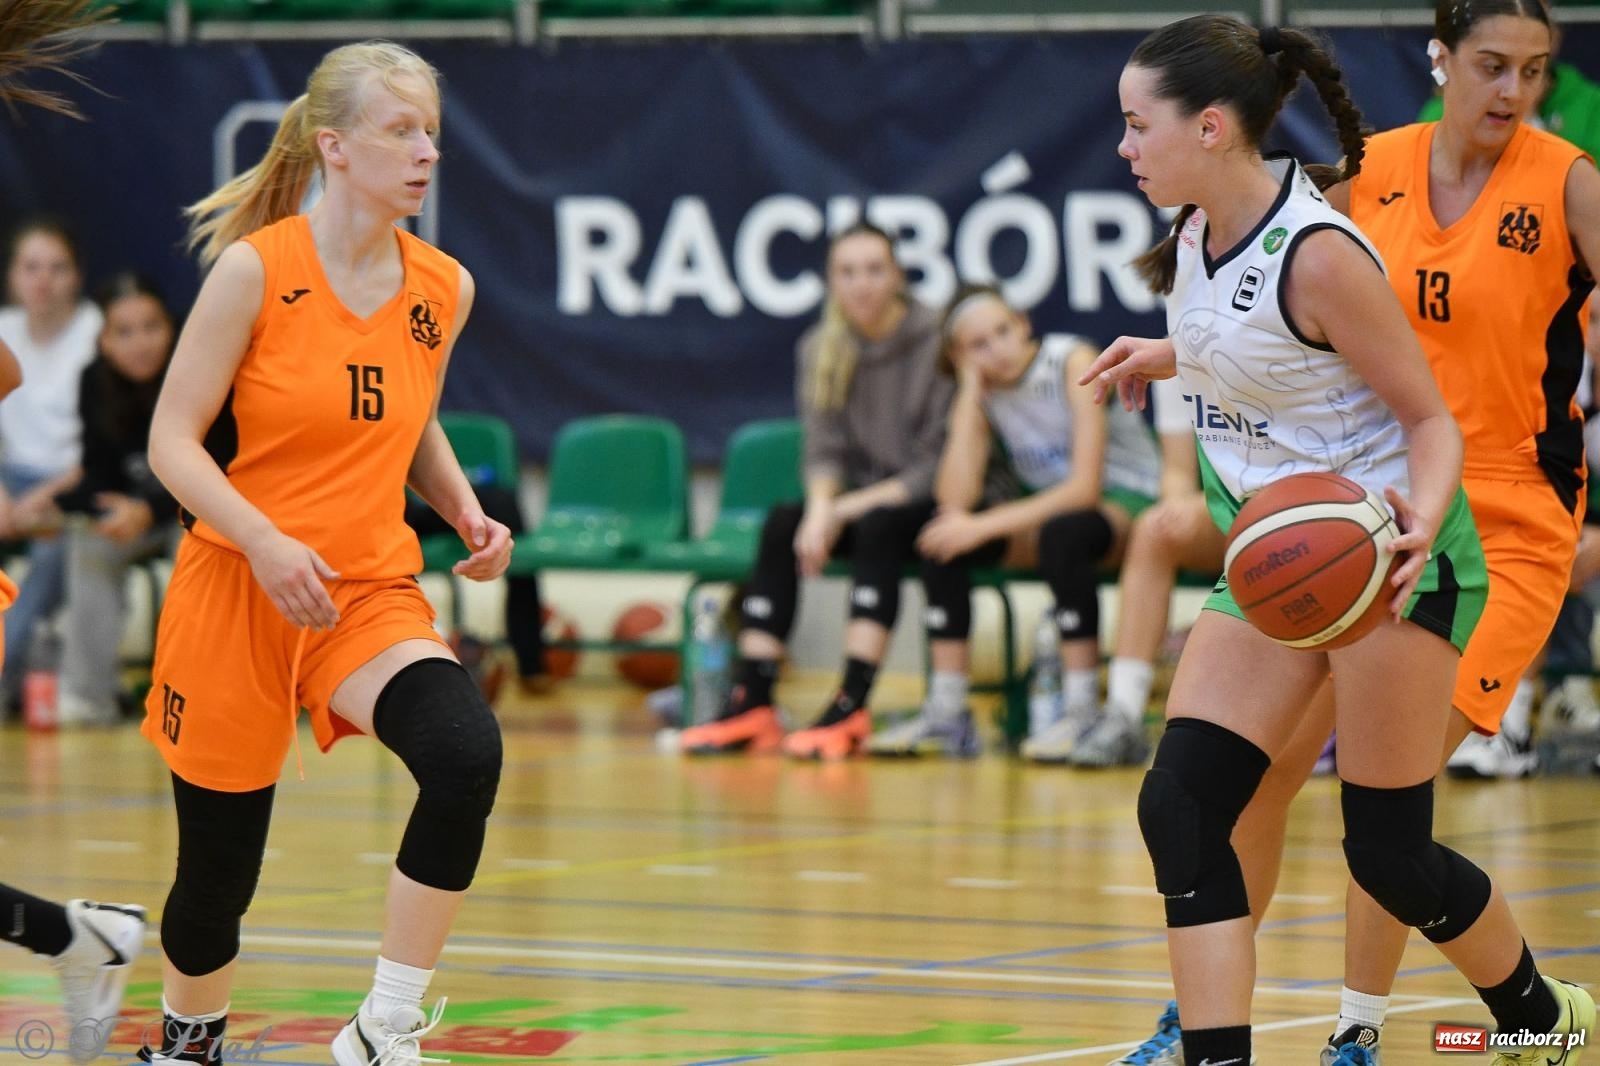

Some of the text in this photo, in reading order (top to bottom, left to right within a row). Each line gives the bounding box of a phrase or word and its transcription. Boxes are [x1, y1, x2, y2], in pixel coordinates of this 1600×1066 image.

[556, 153, 1180, 317] RACBÓR
[1232, 266, 1265, 312] 8
[1416, 268, 1450, 323] 13
[347, 364, 384, 421] 15
[1243, 539, 1310, 585] molten
[163, 683, 186, 746] 15
